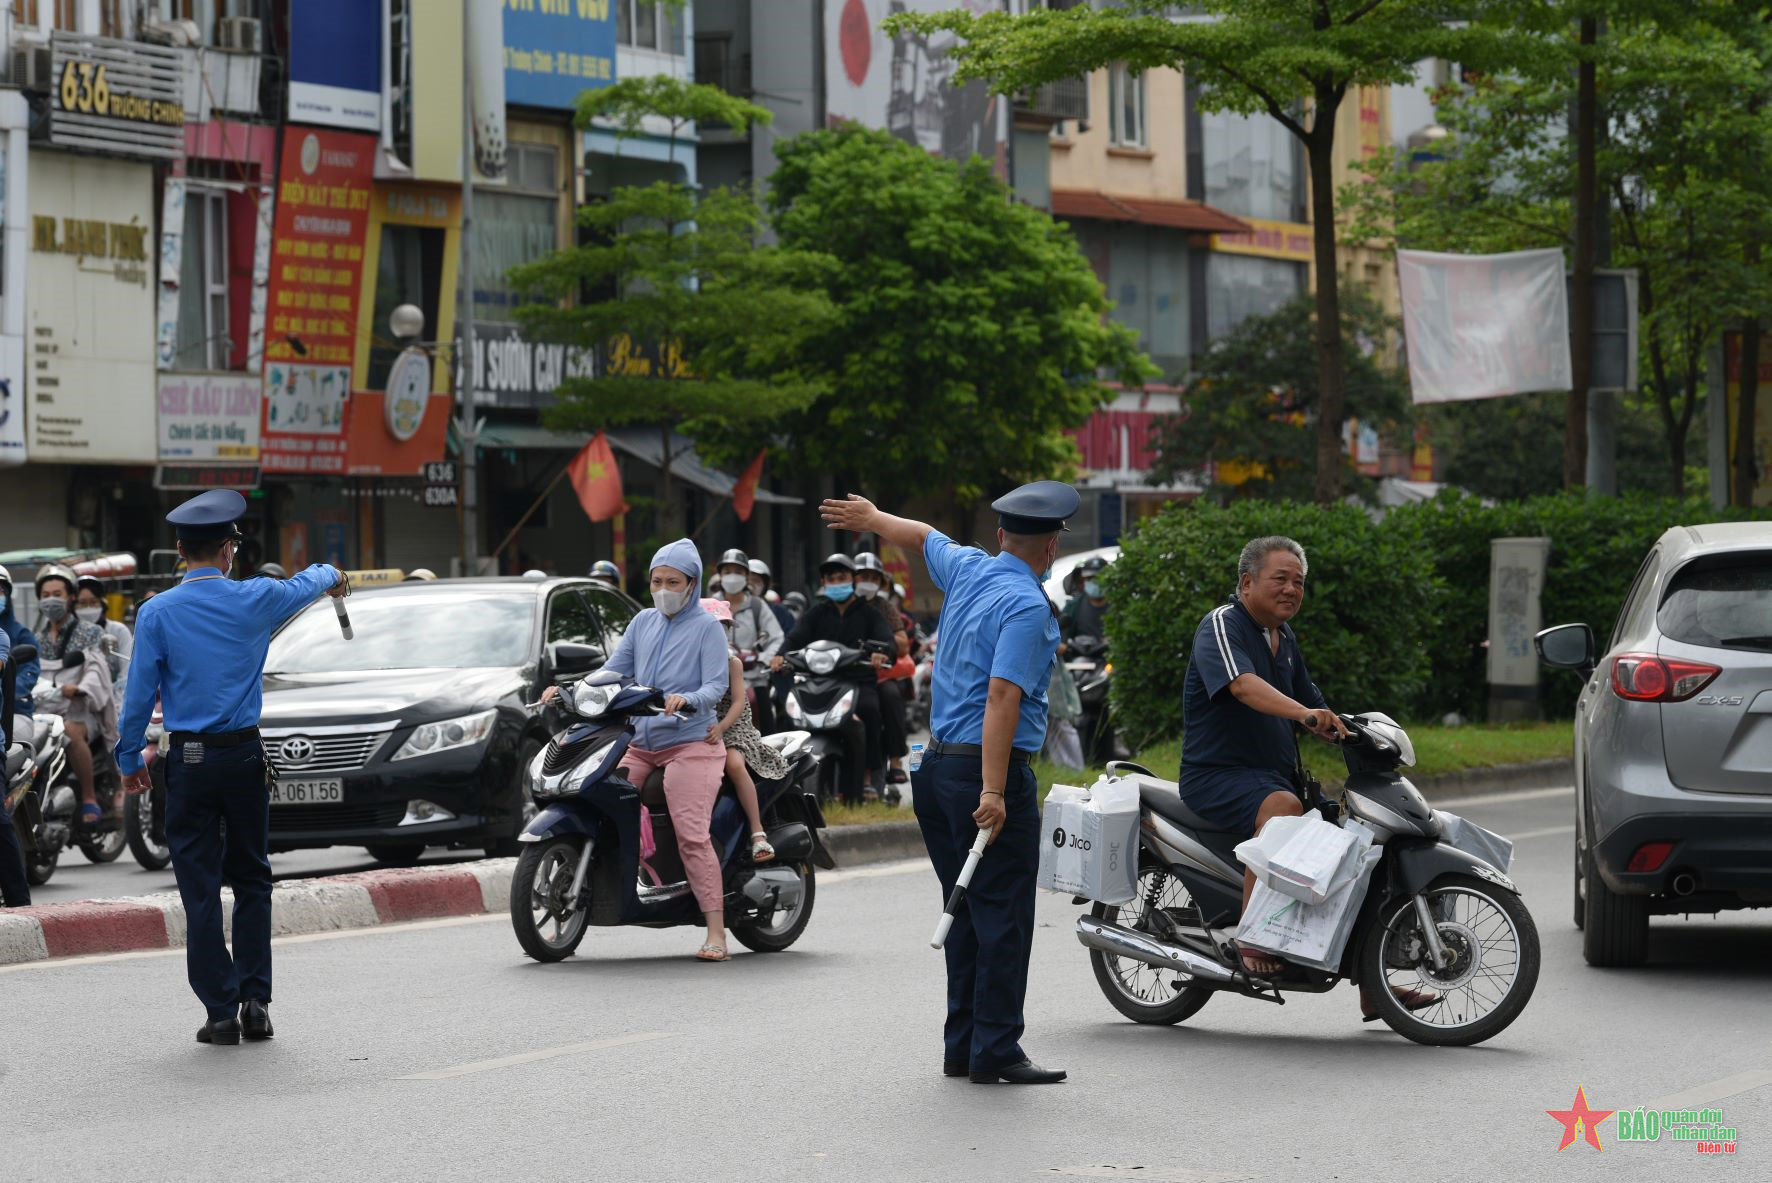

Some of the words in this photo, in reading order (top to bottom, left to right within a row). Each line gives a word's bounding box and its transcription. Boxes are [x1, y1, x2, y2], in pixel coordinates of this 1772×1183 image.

[61, 59, 109, 115] 636
[151, 100, 184, 126] CHINH
[361, 573, 388, 582] TAXI
